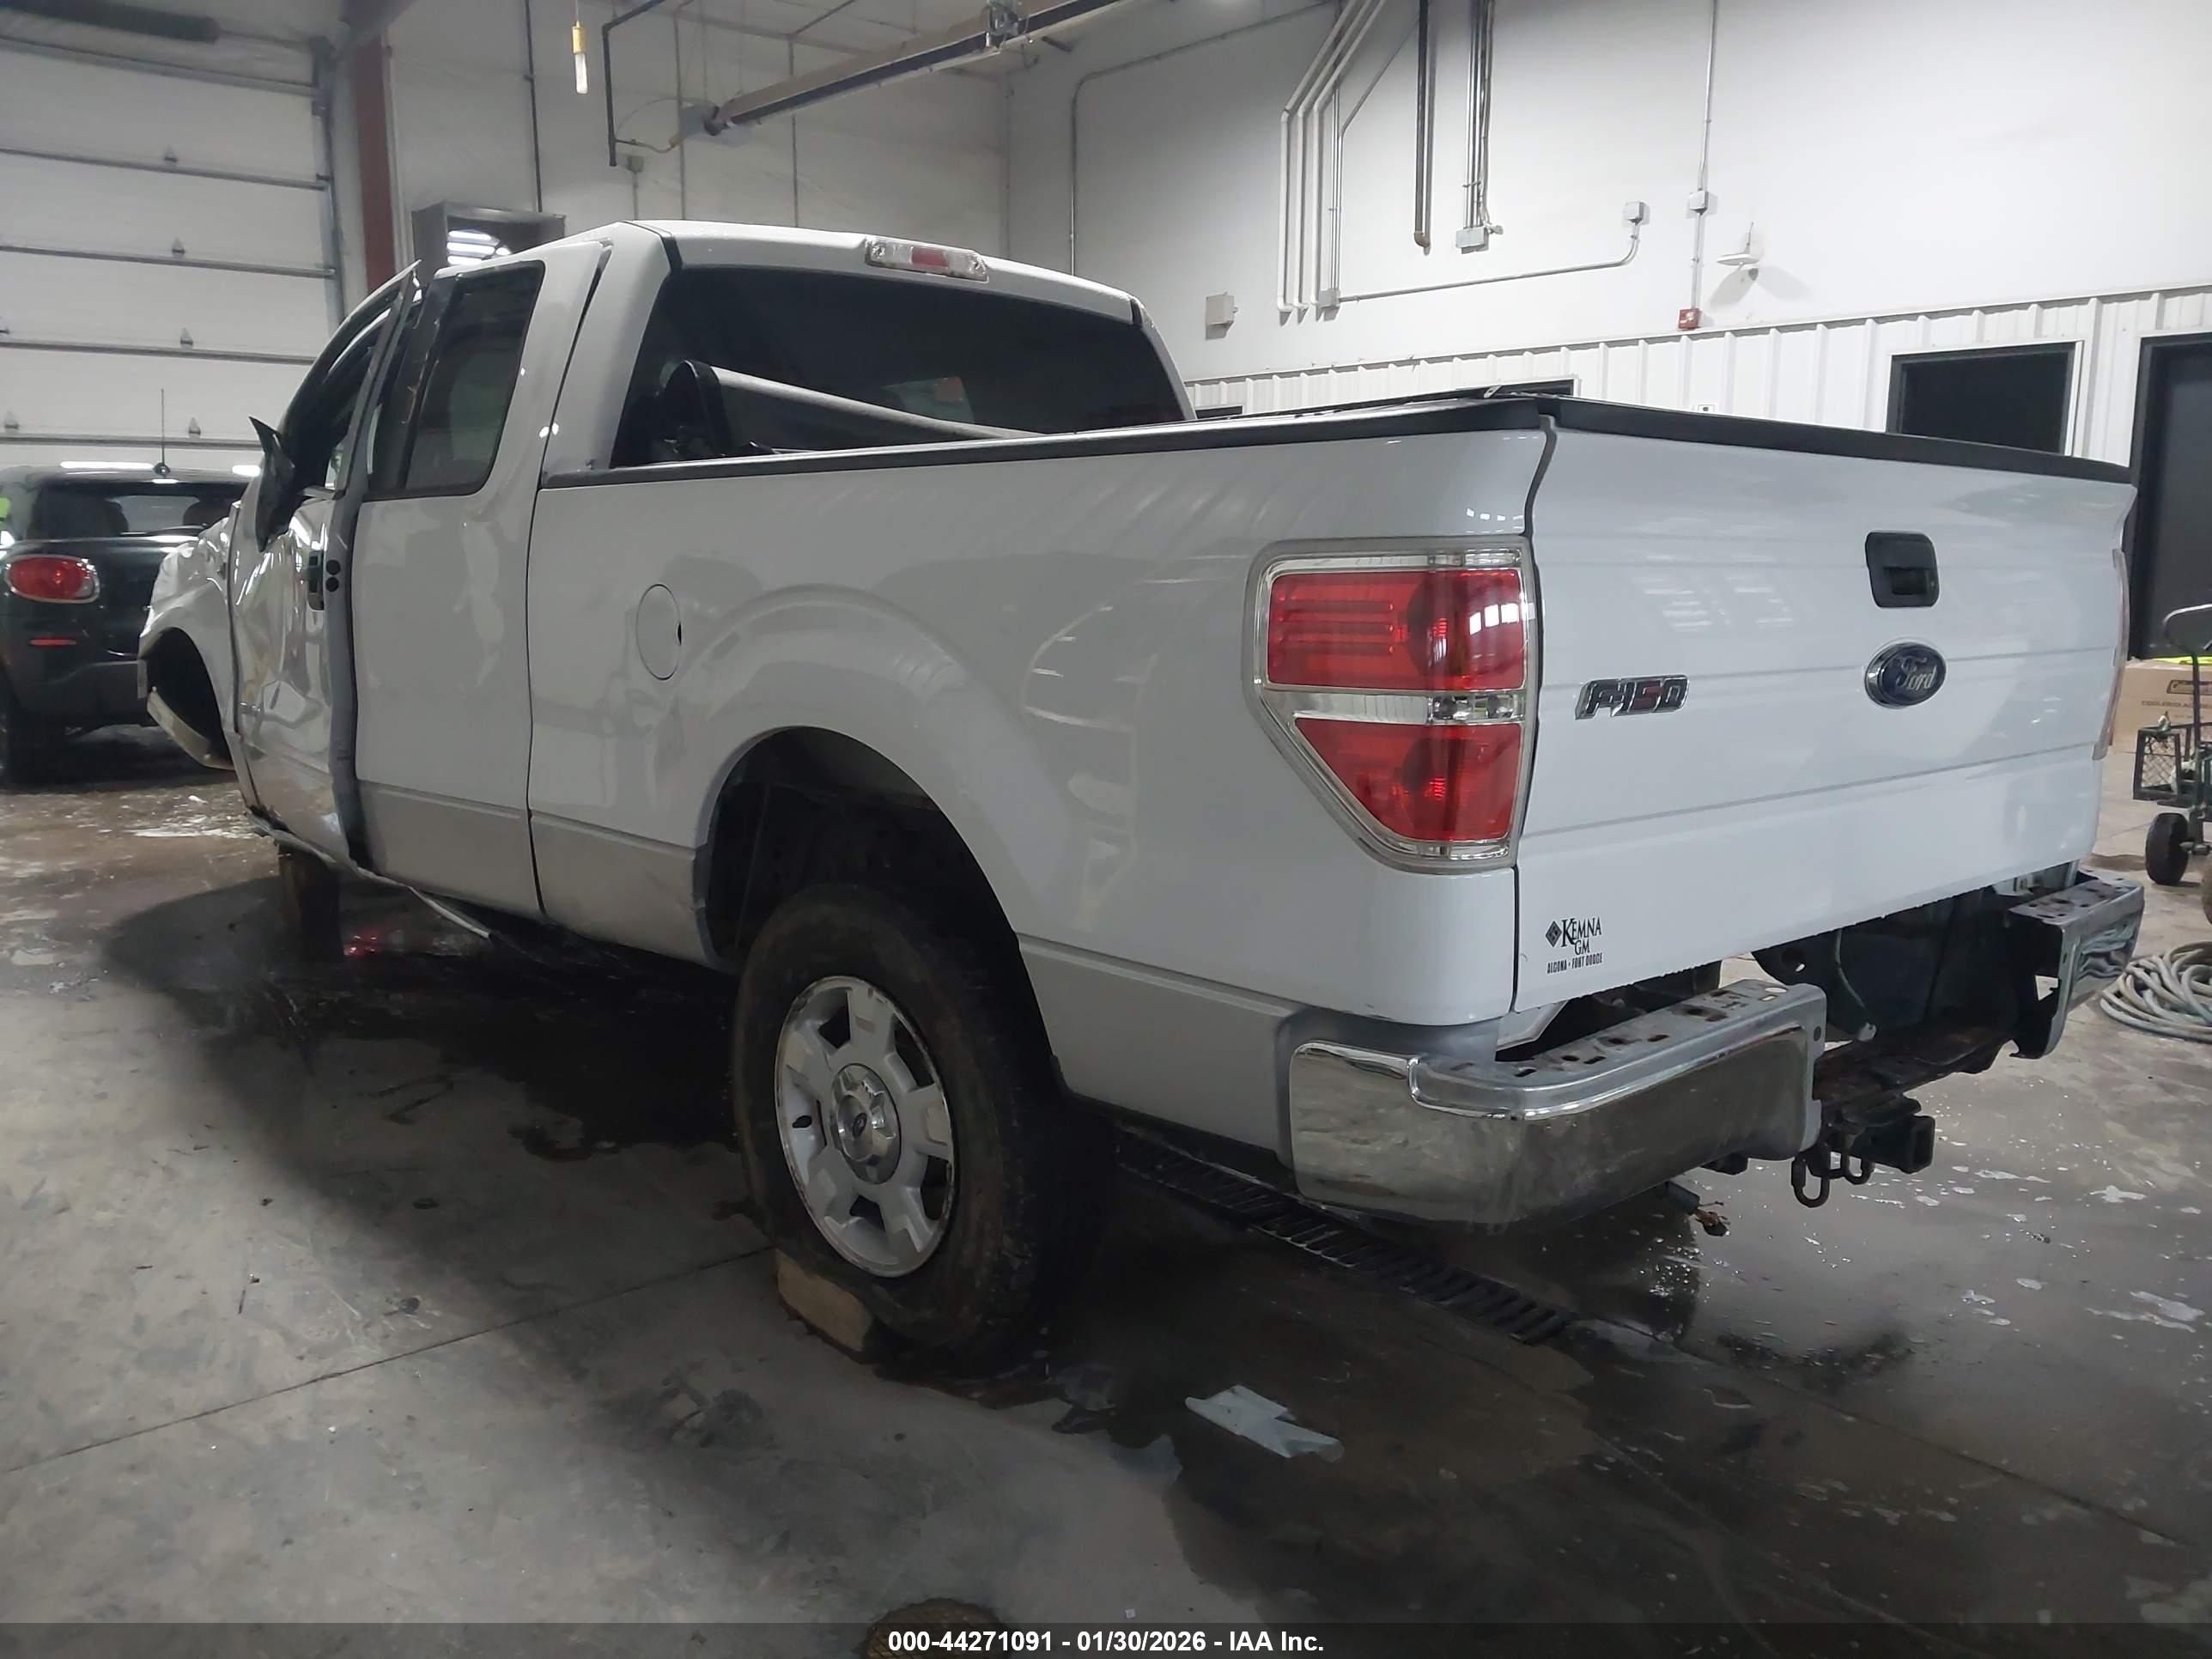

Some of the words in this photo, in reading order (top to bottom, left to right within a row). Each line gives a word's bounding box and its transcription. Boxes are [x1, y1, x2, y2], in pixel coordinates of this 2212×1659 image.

[1560, 916, 1602, 947] KEMNA
[1574, 939, 1589, 955] GM
[1572, 956, 1584, 969] FORT
[1585, 952, 1602, 966] DODGE
